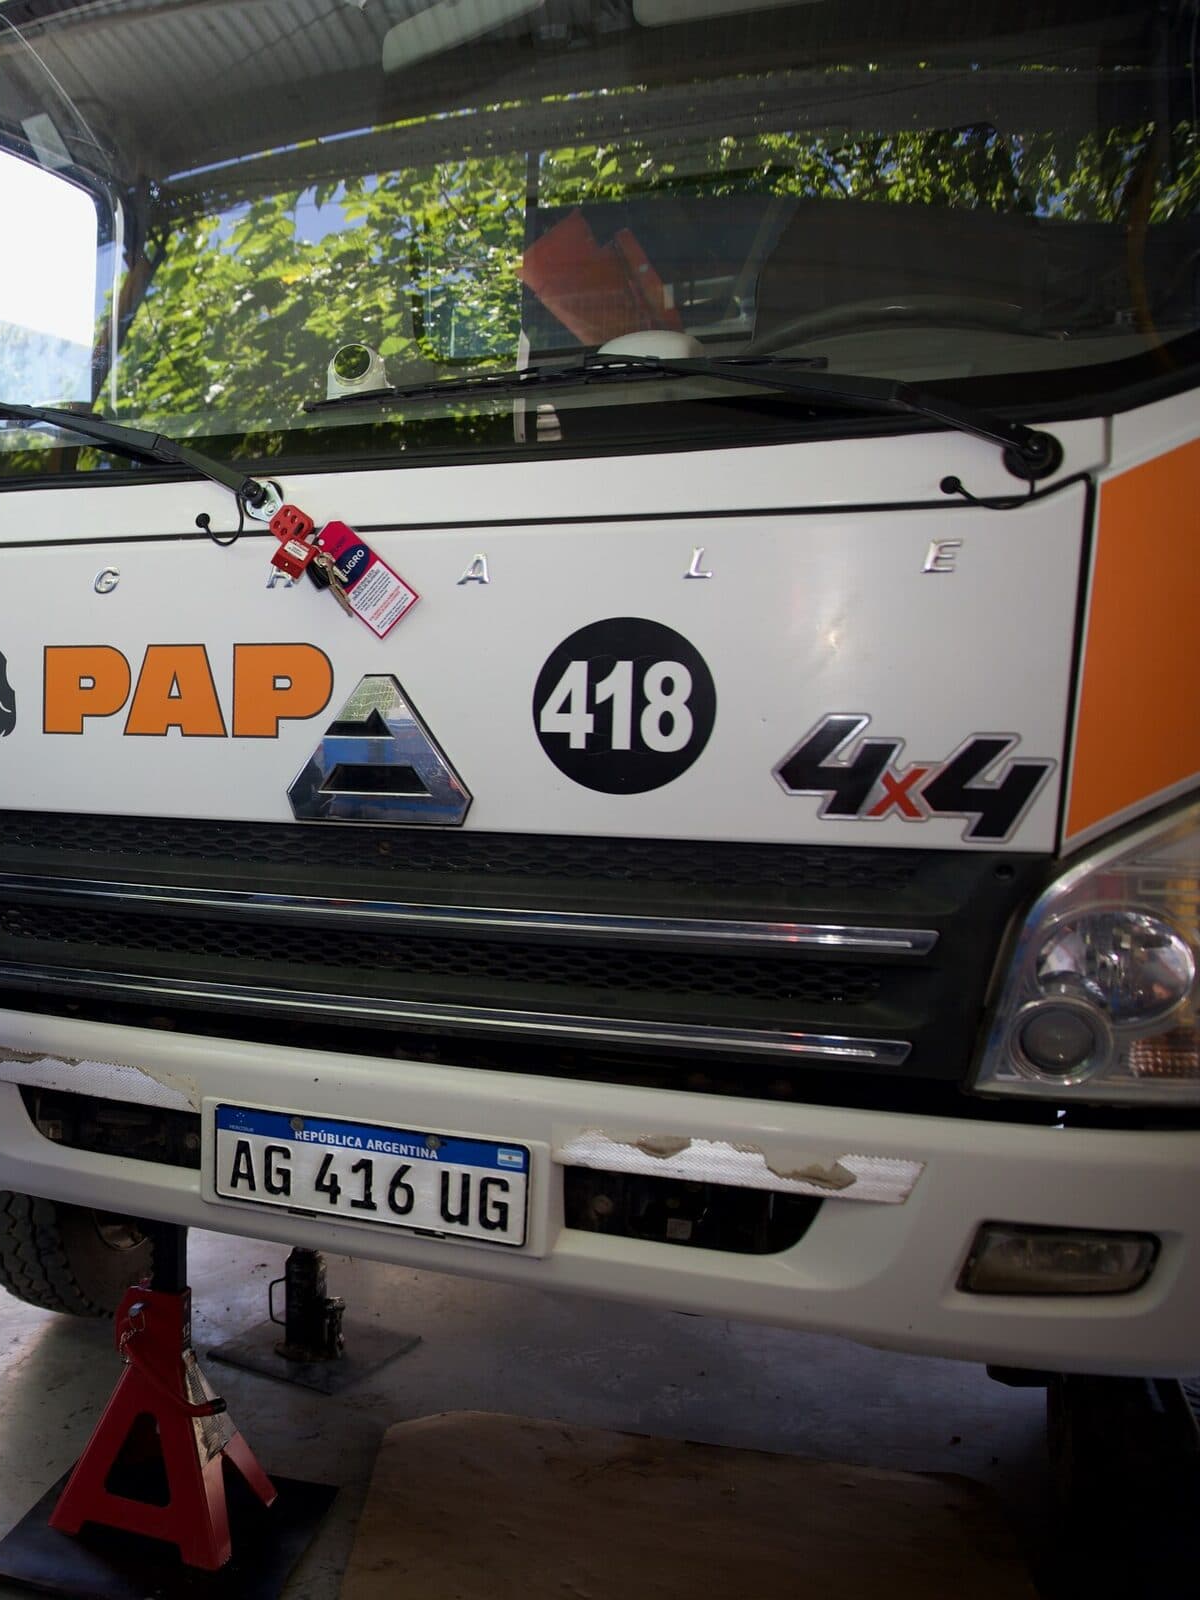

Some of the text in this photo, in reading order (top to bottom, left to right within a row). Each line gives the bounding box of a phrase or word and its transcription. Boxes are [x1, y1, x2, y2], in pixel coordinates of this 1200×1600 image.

[43, 642, 334, 738] PAP
[540, 660, 693, 752] 418
[230, 1139, 510, 1232] AG 416 UG
[295, 1128, 438, 1160] REPÚBLICA ARGENTINA
